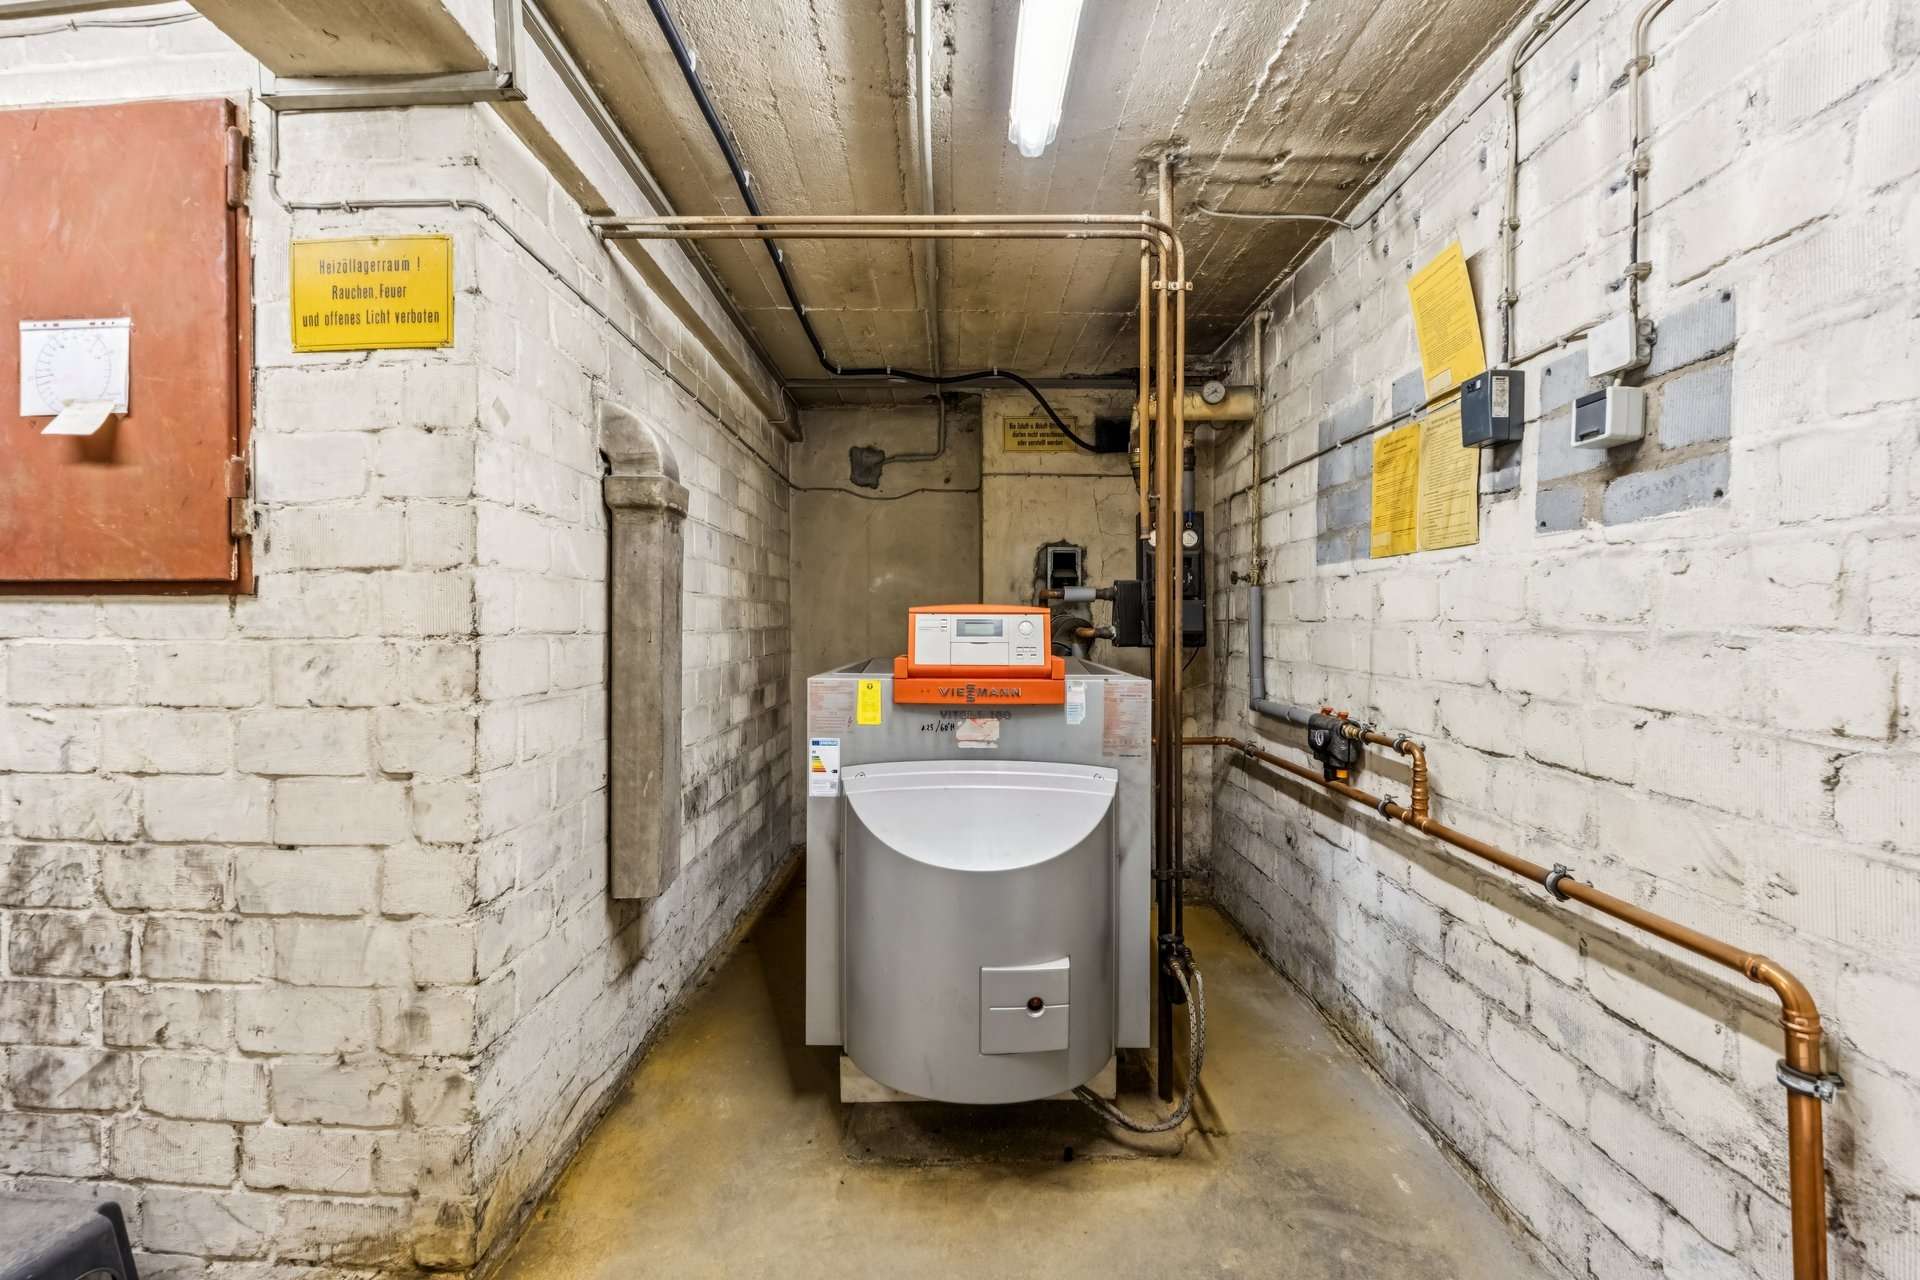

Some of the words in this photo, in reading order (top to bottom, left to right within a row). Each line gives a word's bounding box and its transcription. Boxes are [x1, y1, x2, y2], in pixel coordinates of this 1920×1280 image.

[319, 256, 410, 275] Heizöllagerraum
[379, 283, 407, 298] Feuer
[302, 312, 320, 327] und
[324, 311, 361, 326] offenes
[366, 309, 391, 325] Licht
[395, 308, 440, 324] verboten
